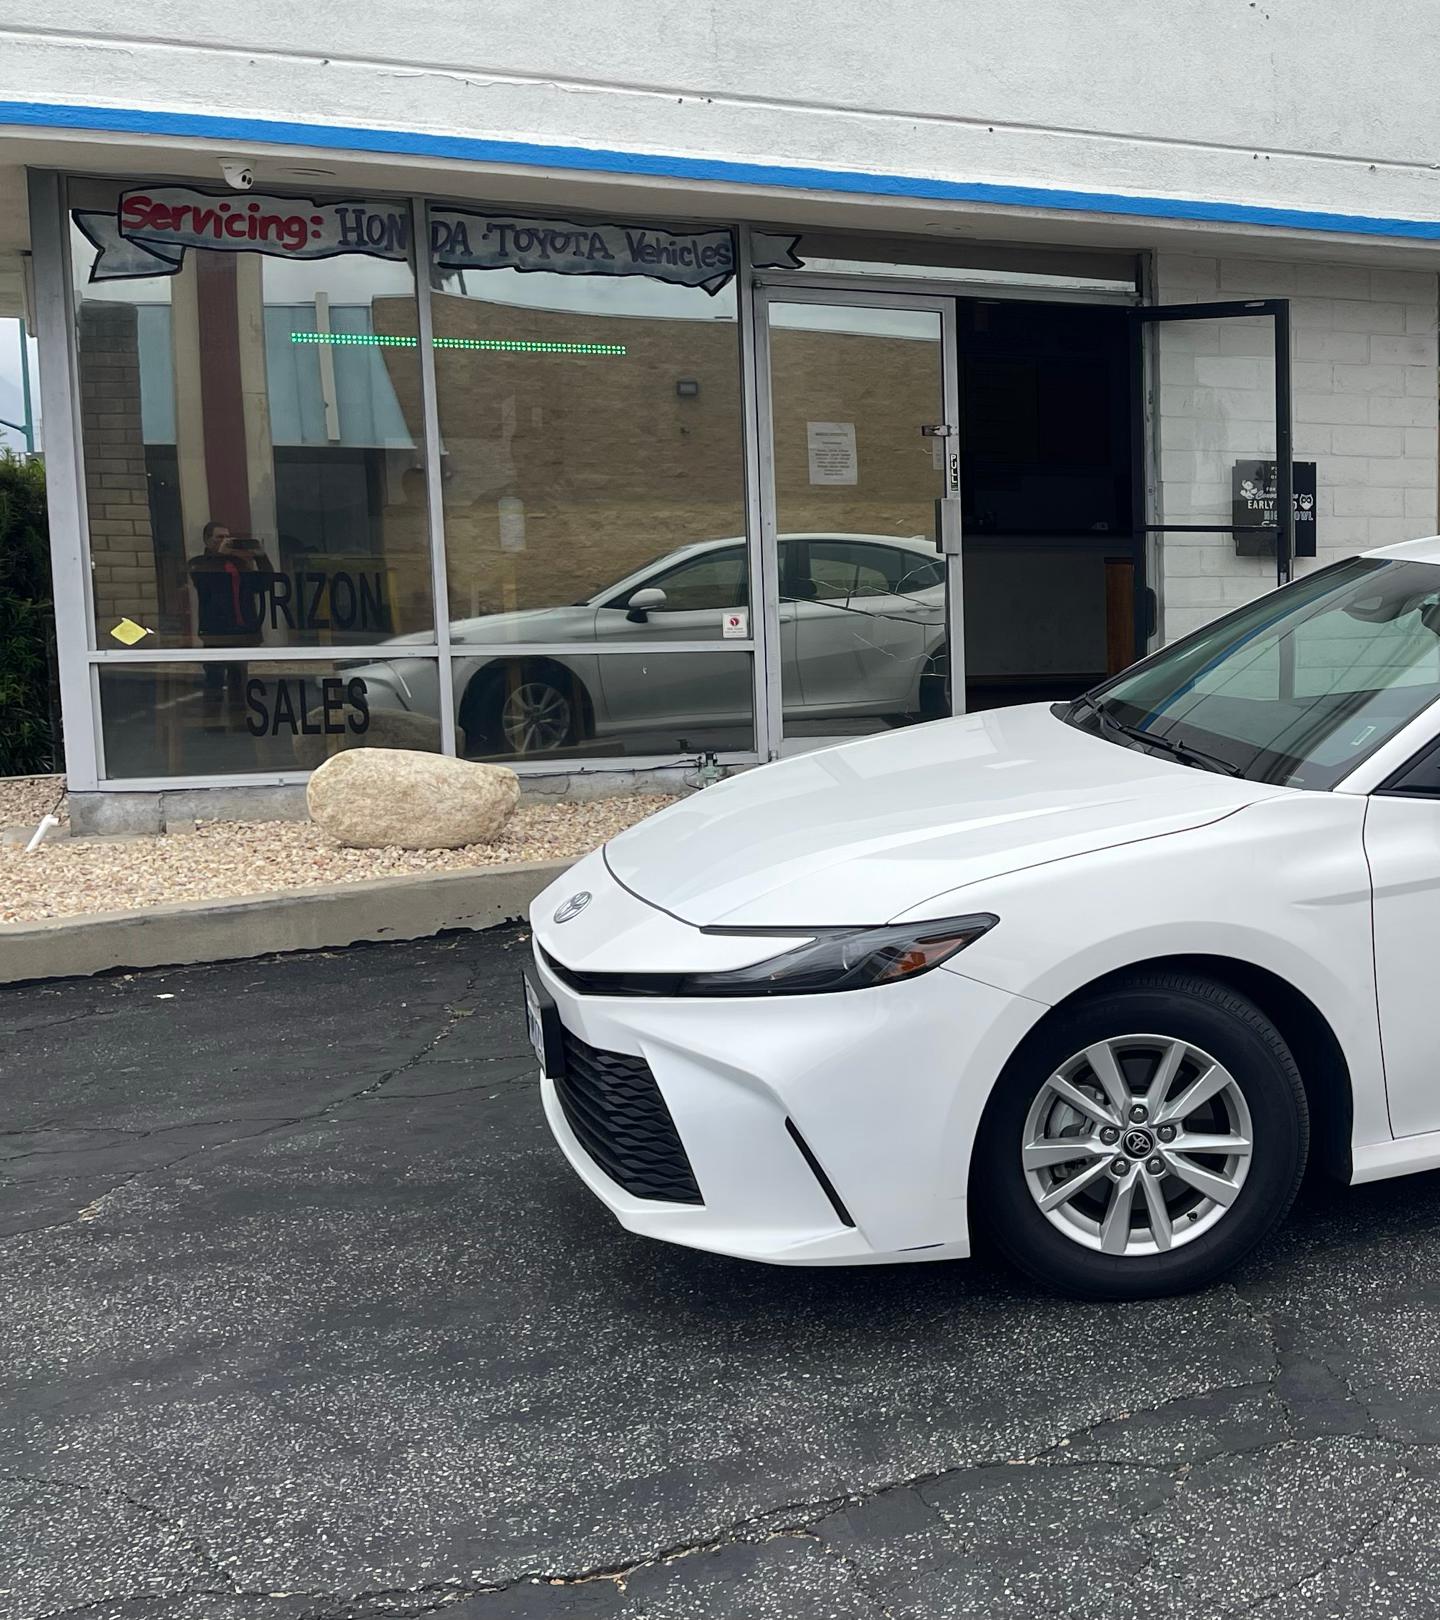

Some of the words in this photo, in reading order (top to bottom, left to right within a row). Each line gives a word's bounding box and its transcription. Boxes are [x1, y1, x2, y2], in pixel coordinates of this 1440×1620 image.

[122, 195, 325, 250] Servicing:
[624, 231, 732, 269] Vehicles
[1247, 500, 1274, 510] EARLY
[246, 677, 370, 737] SALES
